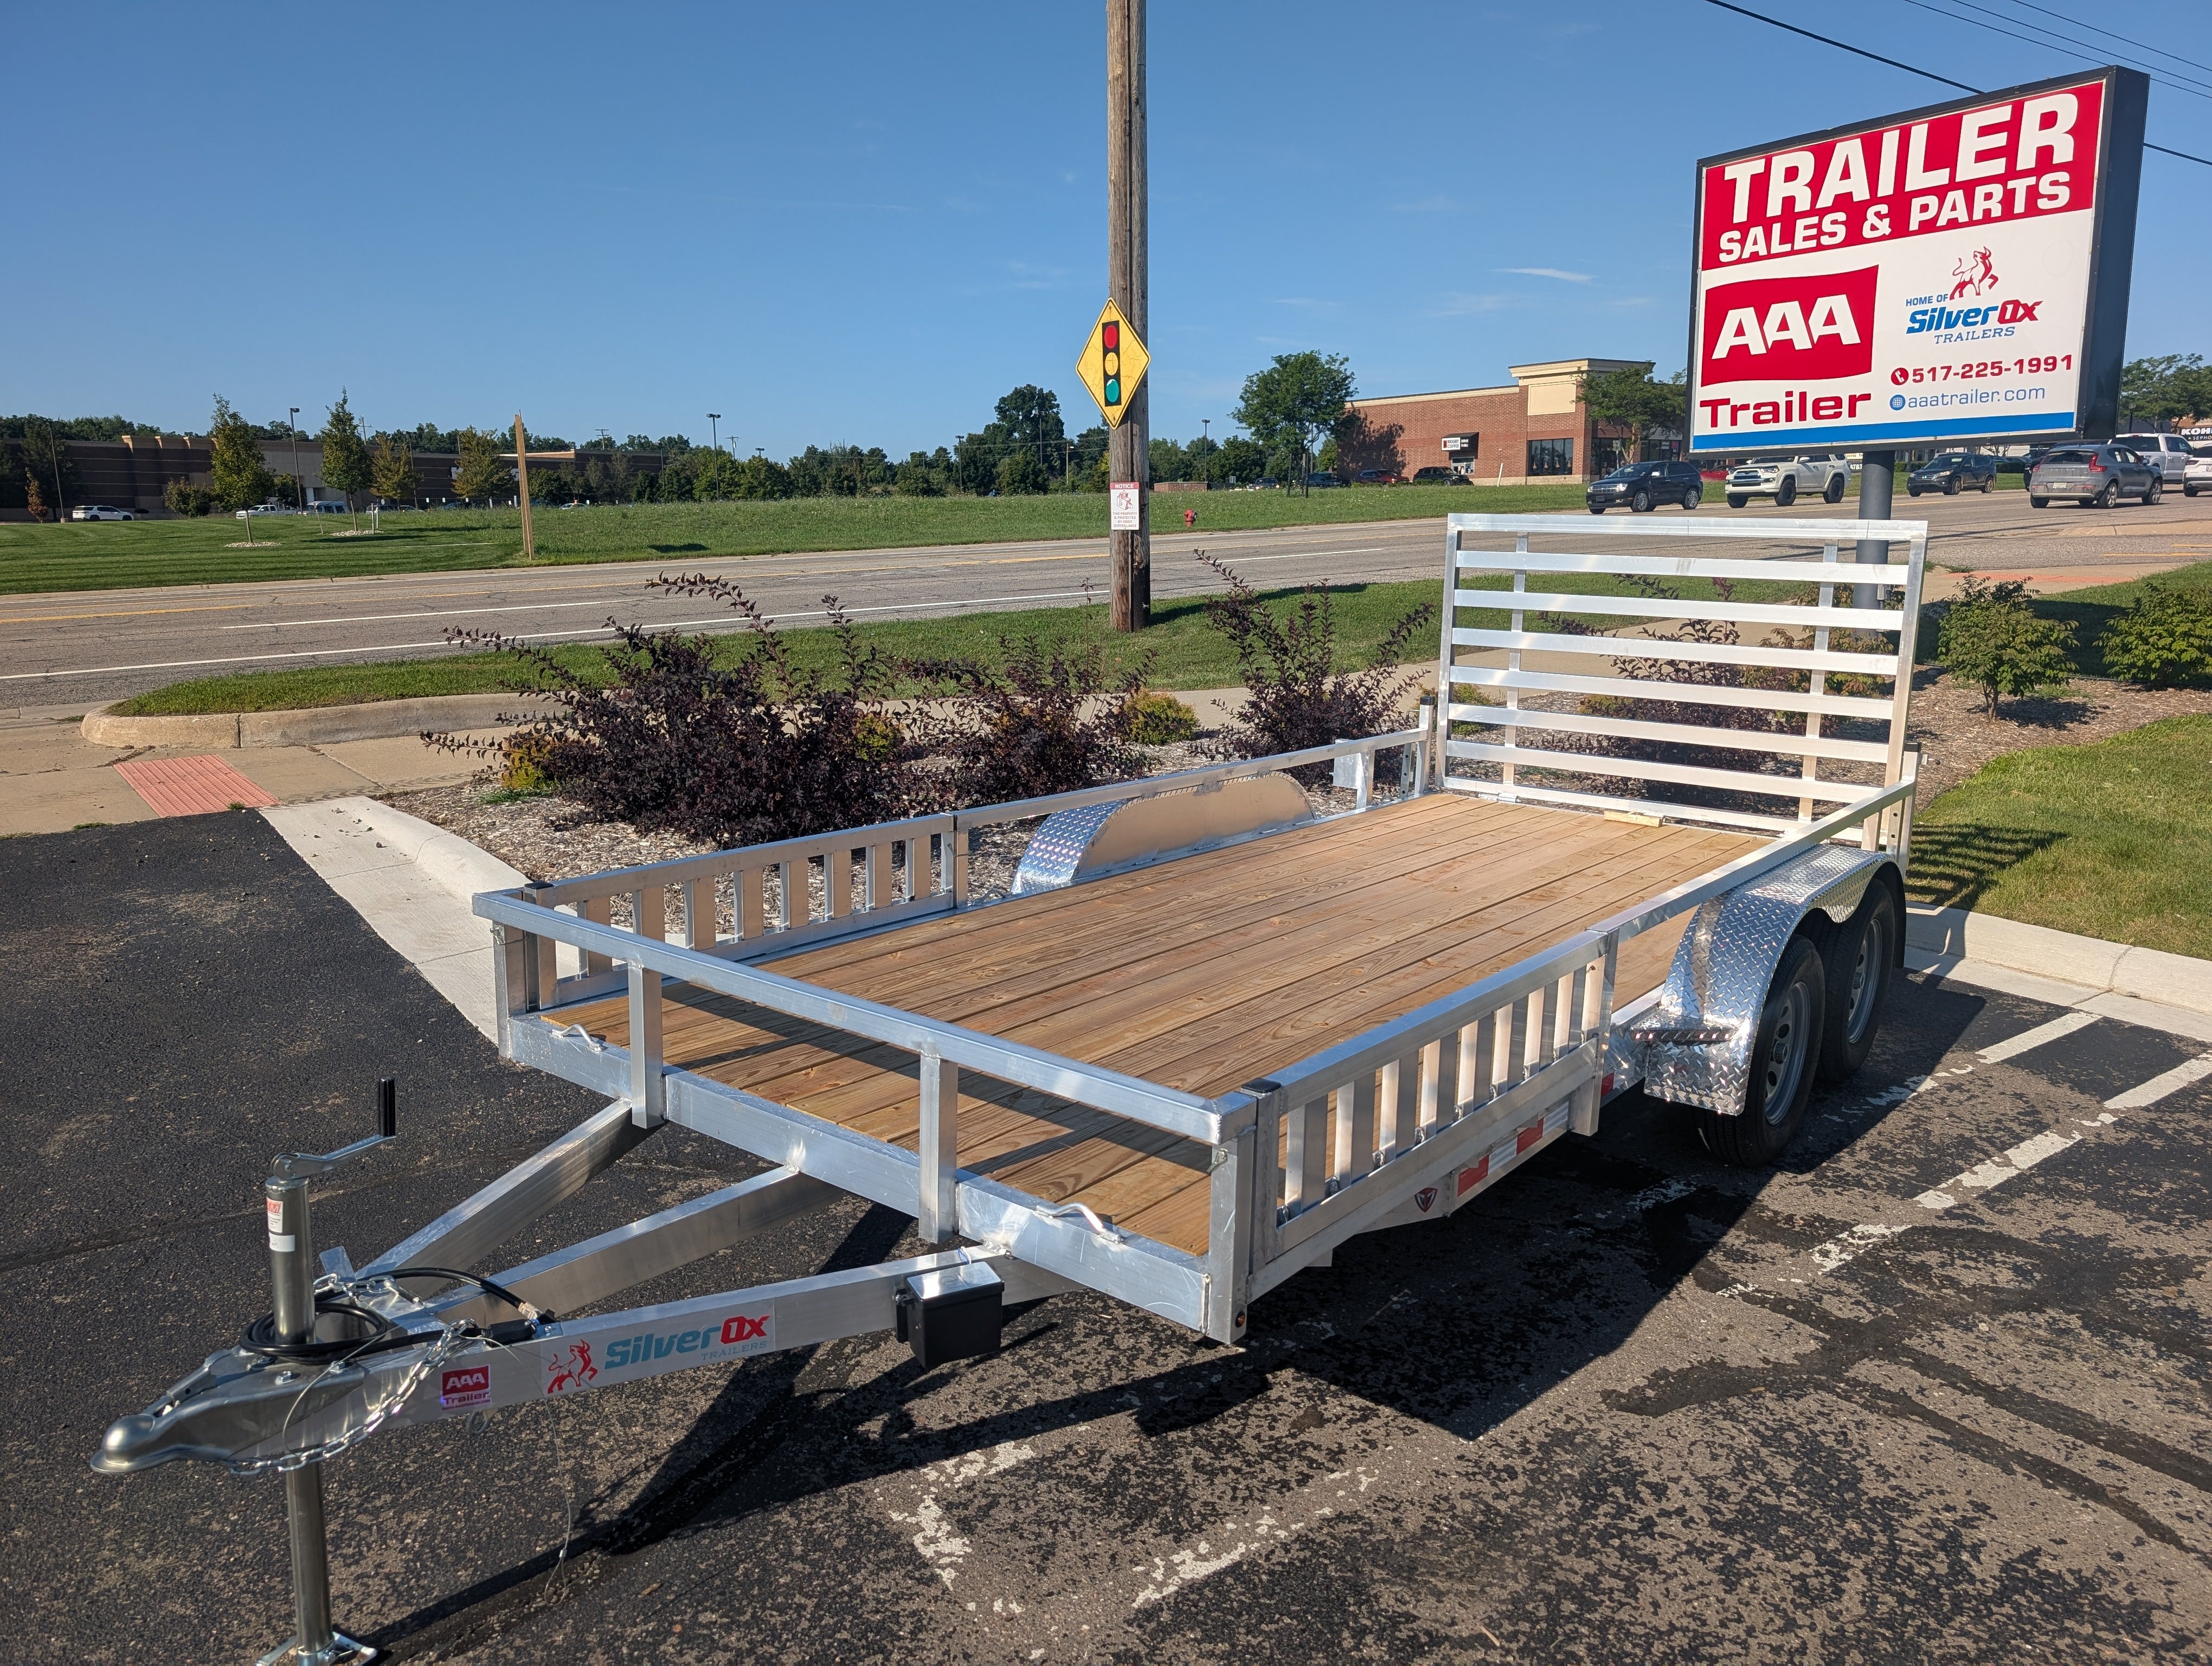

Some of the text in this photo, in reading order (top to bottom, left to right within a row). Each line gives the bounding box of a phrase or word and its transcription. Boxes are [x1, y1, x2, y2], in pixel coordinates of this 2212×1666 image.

[1724, 92, 2079, 223] TRAILER
[1718, 171, 2070, 262] SALES & PARTS
[1905, 293, 1949, 307] HOME OF
[1711, 293, 1861, 360] AAA
[1933, 326, 2016, 344] TRAILERS
[1911, 354, 2073, 383] 517-225-1991
[1907, 387, 2046, 408] aaatrailer.com
[1699, 389, 1872, 428] Trailer
[2181, 427, 2212, 435] KOH
[701, 1340, 767, 1360] TRAILERS
[446, 1373, 486, 1390] AAA
[442, 1392, 490, 1405] Trailer
